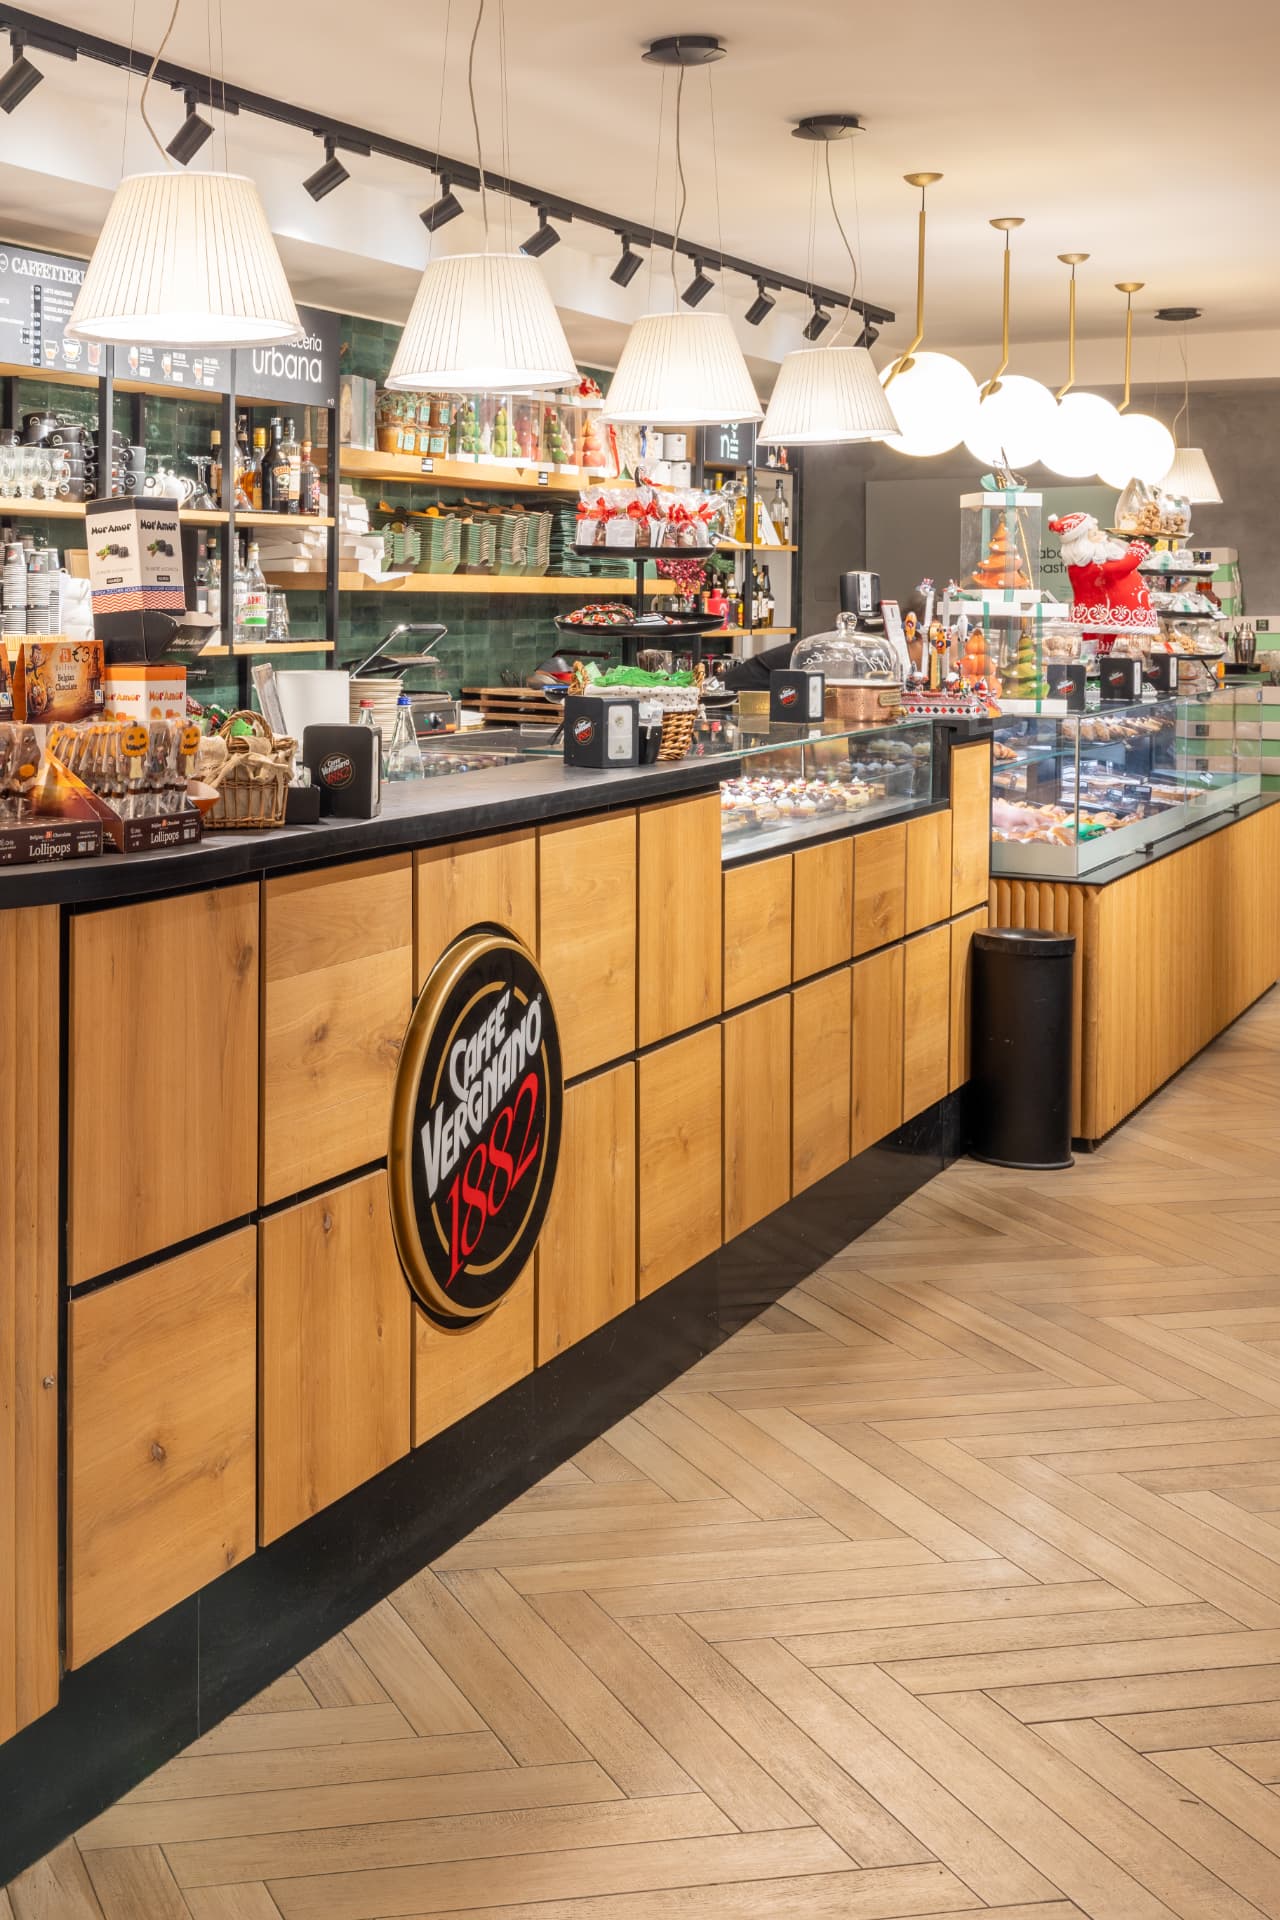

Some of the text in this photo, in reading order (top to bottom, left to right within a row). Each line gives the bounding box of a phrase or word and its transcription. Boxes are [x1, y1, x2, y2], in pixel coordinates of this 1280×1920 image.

[11, 257, 86, 285] CAFFETTERI
[252, 346, 322, 383] urbana
[105, 693, 141, 701] or'Amor
[29, 842, 71, 857] Lollipops
[150, 831, 180, 844] Lollipops
[421, 1000, 542, 1199] VERGNANO
[446, 1072, 540, 1289] 1882
